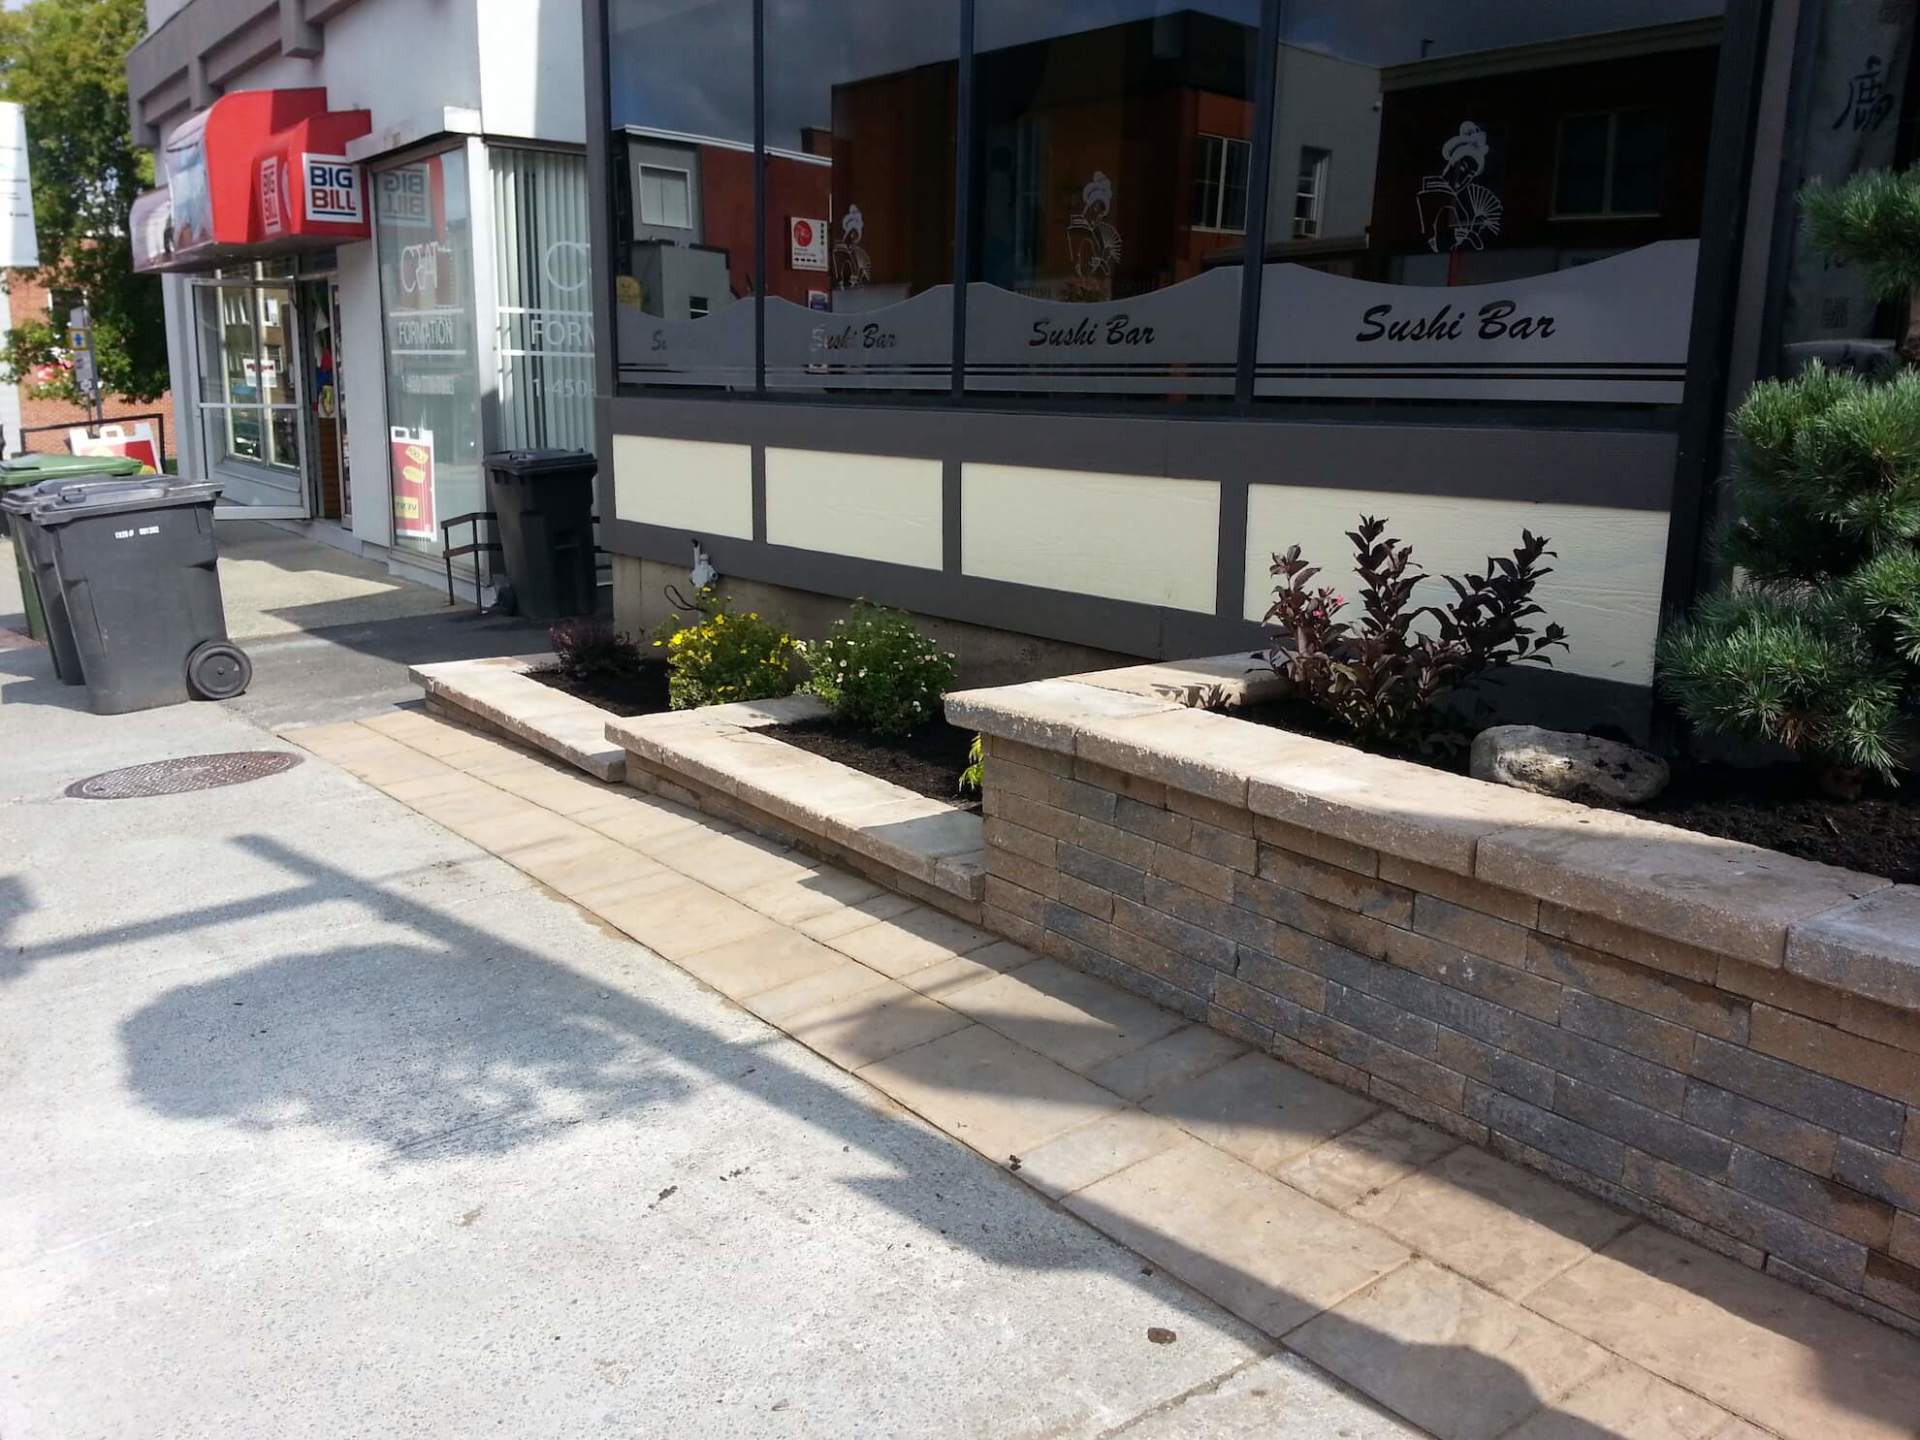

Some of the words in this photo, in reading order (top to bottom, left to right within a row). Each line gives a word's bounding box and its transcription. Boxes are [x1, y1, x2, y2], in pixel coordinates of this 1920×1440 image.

[310, 166, 354, 189] BIG
[312, 188, 357, 211] BILL
[1029, 317, 1098, 347] Sushi
[1106, 314, 1155, 346] Bar
[1356, 304, 1465, 342] Sushi
[1478, 301, 1556, 340] Bar
[862, 323, 897, 349] Bar
